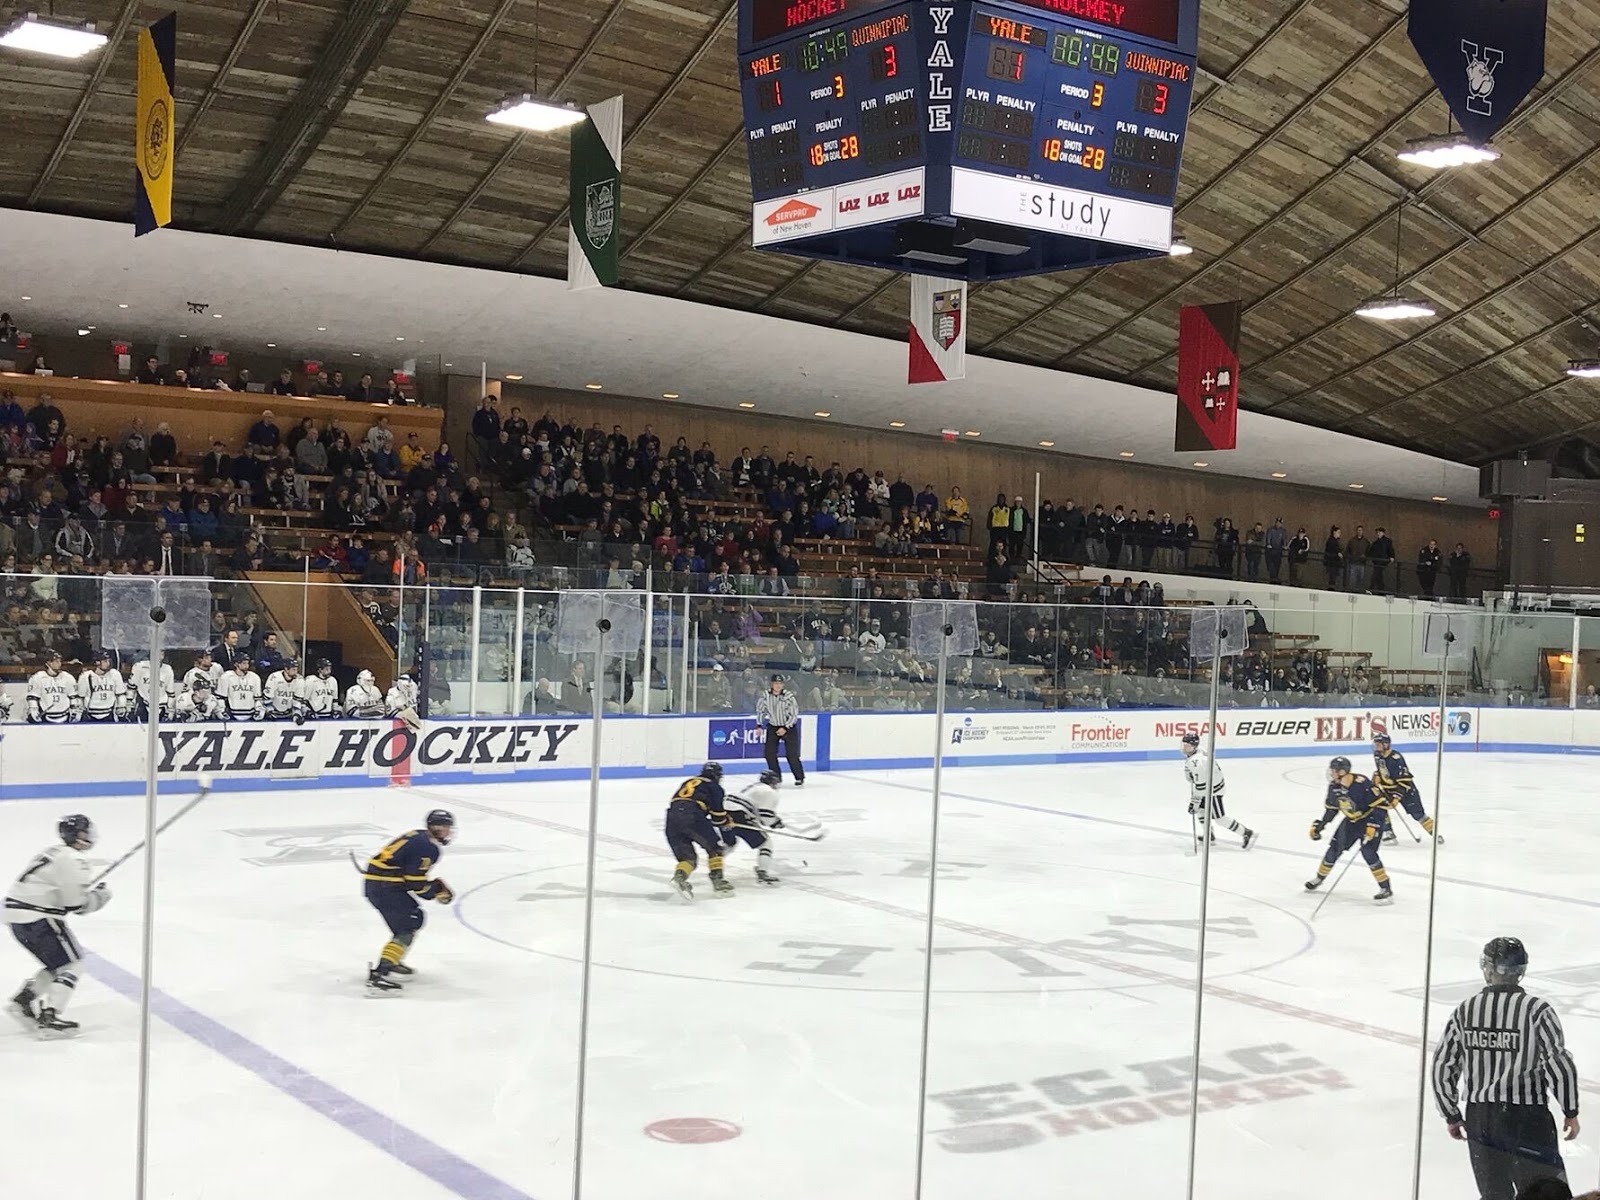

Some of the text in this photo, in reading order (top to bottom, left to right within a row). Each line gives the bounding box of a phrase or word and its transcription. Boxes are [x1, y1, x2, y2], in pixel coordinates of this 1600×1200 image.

[851, 13, 910, 48] QUINNIPIAC
[989, 17, 1033, 44] YALE
[802, 31, 849, 70] 10:49
[884, 45, 897, 77] 3
[751, 53, 781, 77] YALE
[928, 7, 953, 133] YALE
[1016, 52, 1023, 80] 1
[1125, 51, 1191, 82] QUINNIPIAC
[775, 81, 782, 105] 1
[810, 75, 844, 100] PERIOD 3
[861, 88, 915, 111] PLYR PENALTY
[1060, 83, 1104, 107] PERIOD 3
[1153, 83, 1169, 115] 3
[965, 87, 1036, 113] PLYR PENALTY
[750, 119, 797, 140] PLYR PENALTY
[815, 117, 843, 133] PENALTY
[1057, 119, 1095, 136] PENALTY
[1116, 121, 1179, 144] PLYR PENALTY
[810, 144, 823, 166] 18
[823, 140, 839, 152] SHOTS
[829, 150, 842, 161] GOAL
[841, 135, 860, 159] 28
[1043, 139, 1061, 162] 18
[1063, 139, 1083, 152] SHOTS
[1060, 152, 1083, 166] ON GOAL
[1083, 146, 1105, 171] 28
[839, 185, 921, 213] LAZ LAZ LAZ
[1019, 191, 1027, 211] THE
[775, 208, 808, 222] SERVPRO
[1031, 192, 1111, 237] study
[772, 220, 812, 235] of New Haven
[1072, 724, 1131, 741] Frontier
[1155, 722, 1227, 737] NISSAN
[1314, 712, 1387, 741] ELI'S
[1408, 729, 1440, 737] wtnh.co
[157, 724, 579, 772] YALE HOCKEY
[1464, 1030, 1519, 1049] TAGGART
[927, 1041, 1327, 1126] ECAC
[1037, 1068, 1356, 1138] HOCKEY
